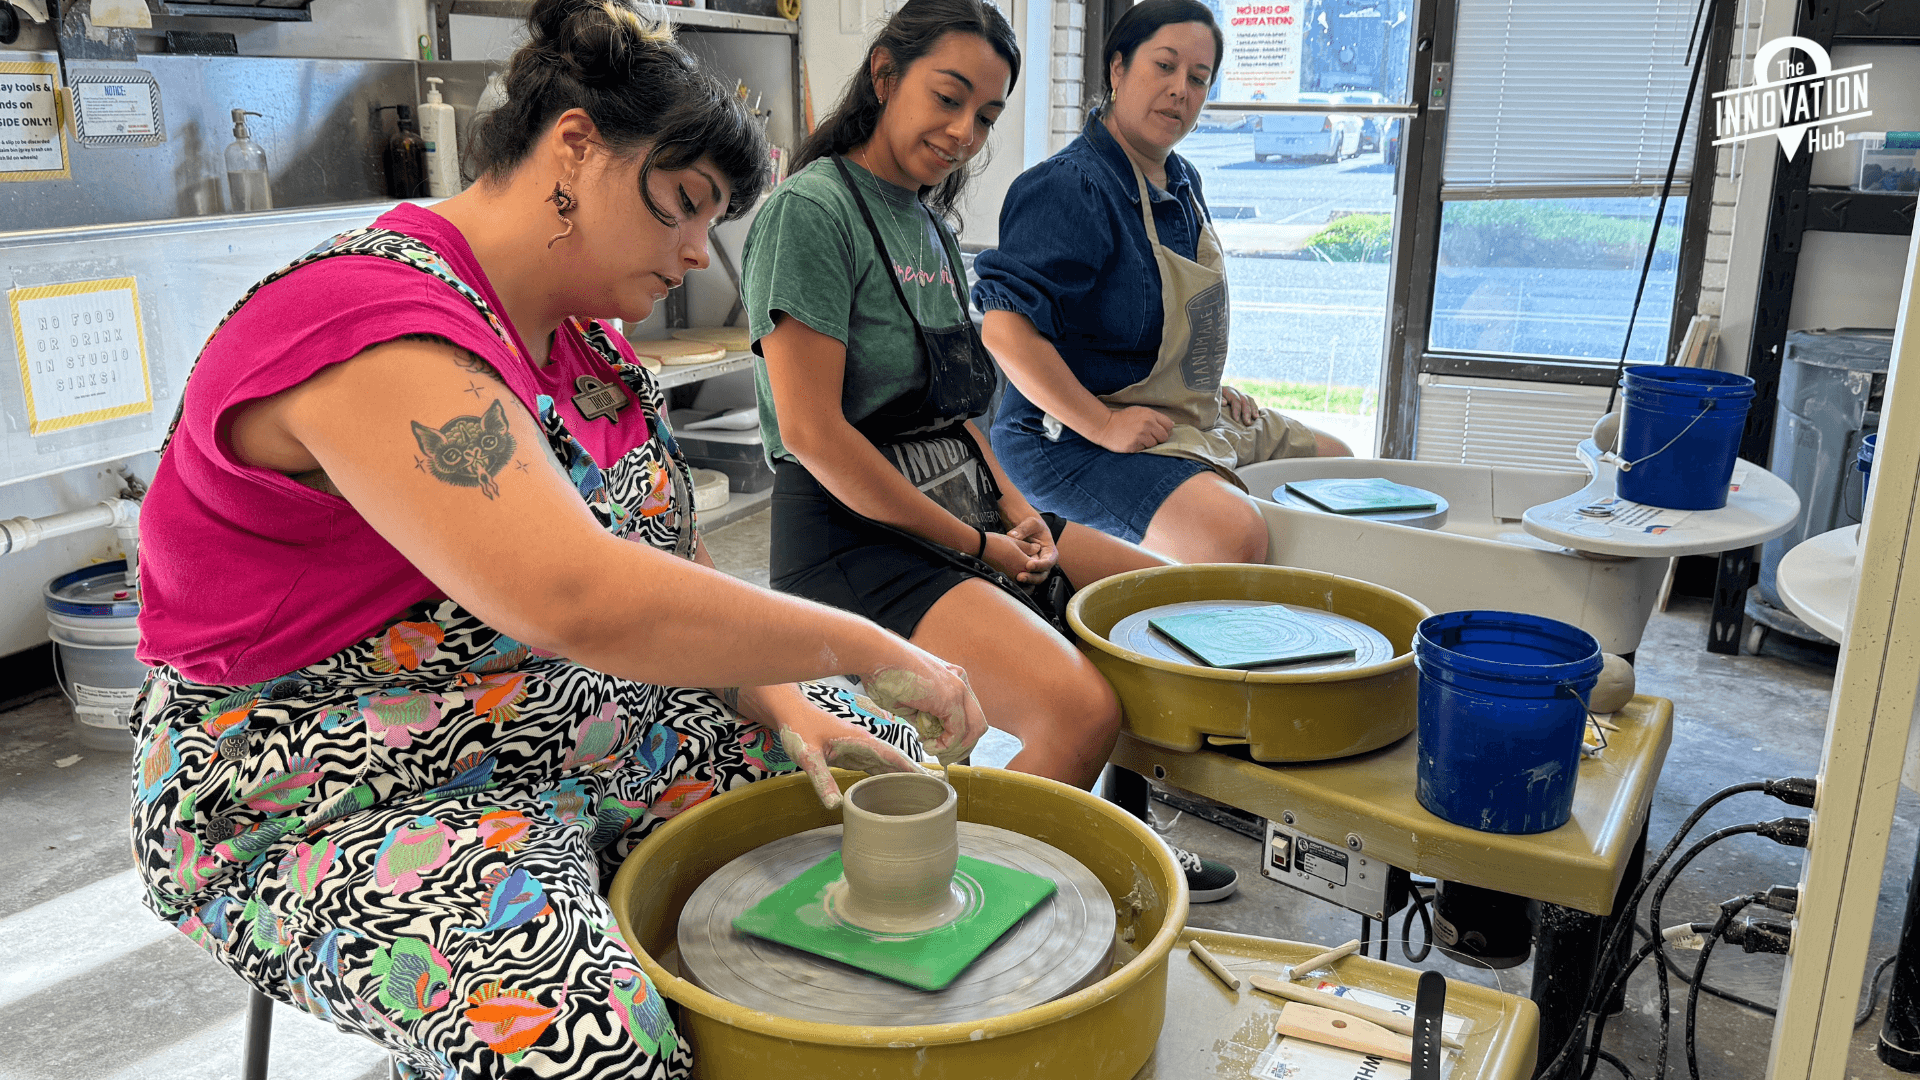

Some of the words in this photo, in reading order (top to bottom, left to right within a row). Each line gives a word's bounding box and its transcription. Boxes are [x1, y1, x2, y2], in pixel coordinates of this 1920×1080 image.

[1236, 5, 1273, 15] HOURS
[1231, 16, 1295, 26] OPERATION
[0, 84, 13, 93] ay
[15, 82, 42, 91] tools
[43, 83, 51, 92] &
[104, 85, 126, 96] NOTICE:
[19, 101, 33, 109] on
[21, 117, 52, 127] ONLY!
[38, 315, 60, 331] NO
[71, 308, 115, 327] FOOD
[37, 338, 59, 353] OR
[70, 328, 123, 348] DRINK
[1191, 308, 1213, 386] HANDMADE
[36, 359, 55, 374] IN
[66, 347, 129, 369] STUDIO
[56, 370, 117, 392] SINKS!
[588, 391, 616, 410] TAYLOR
